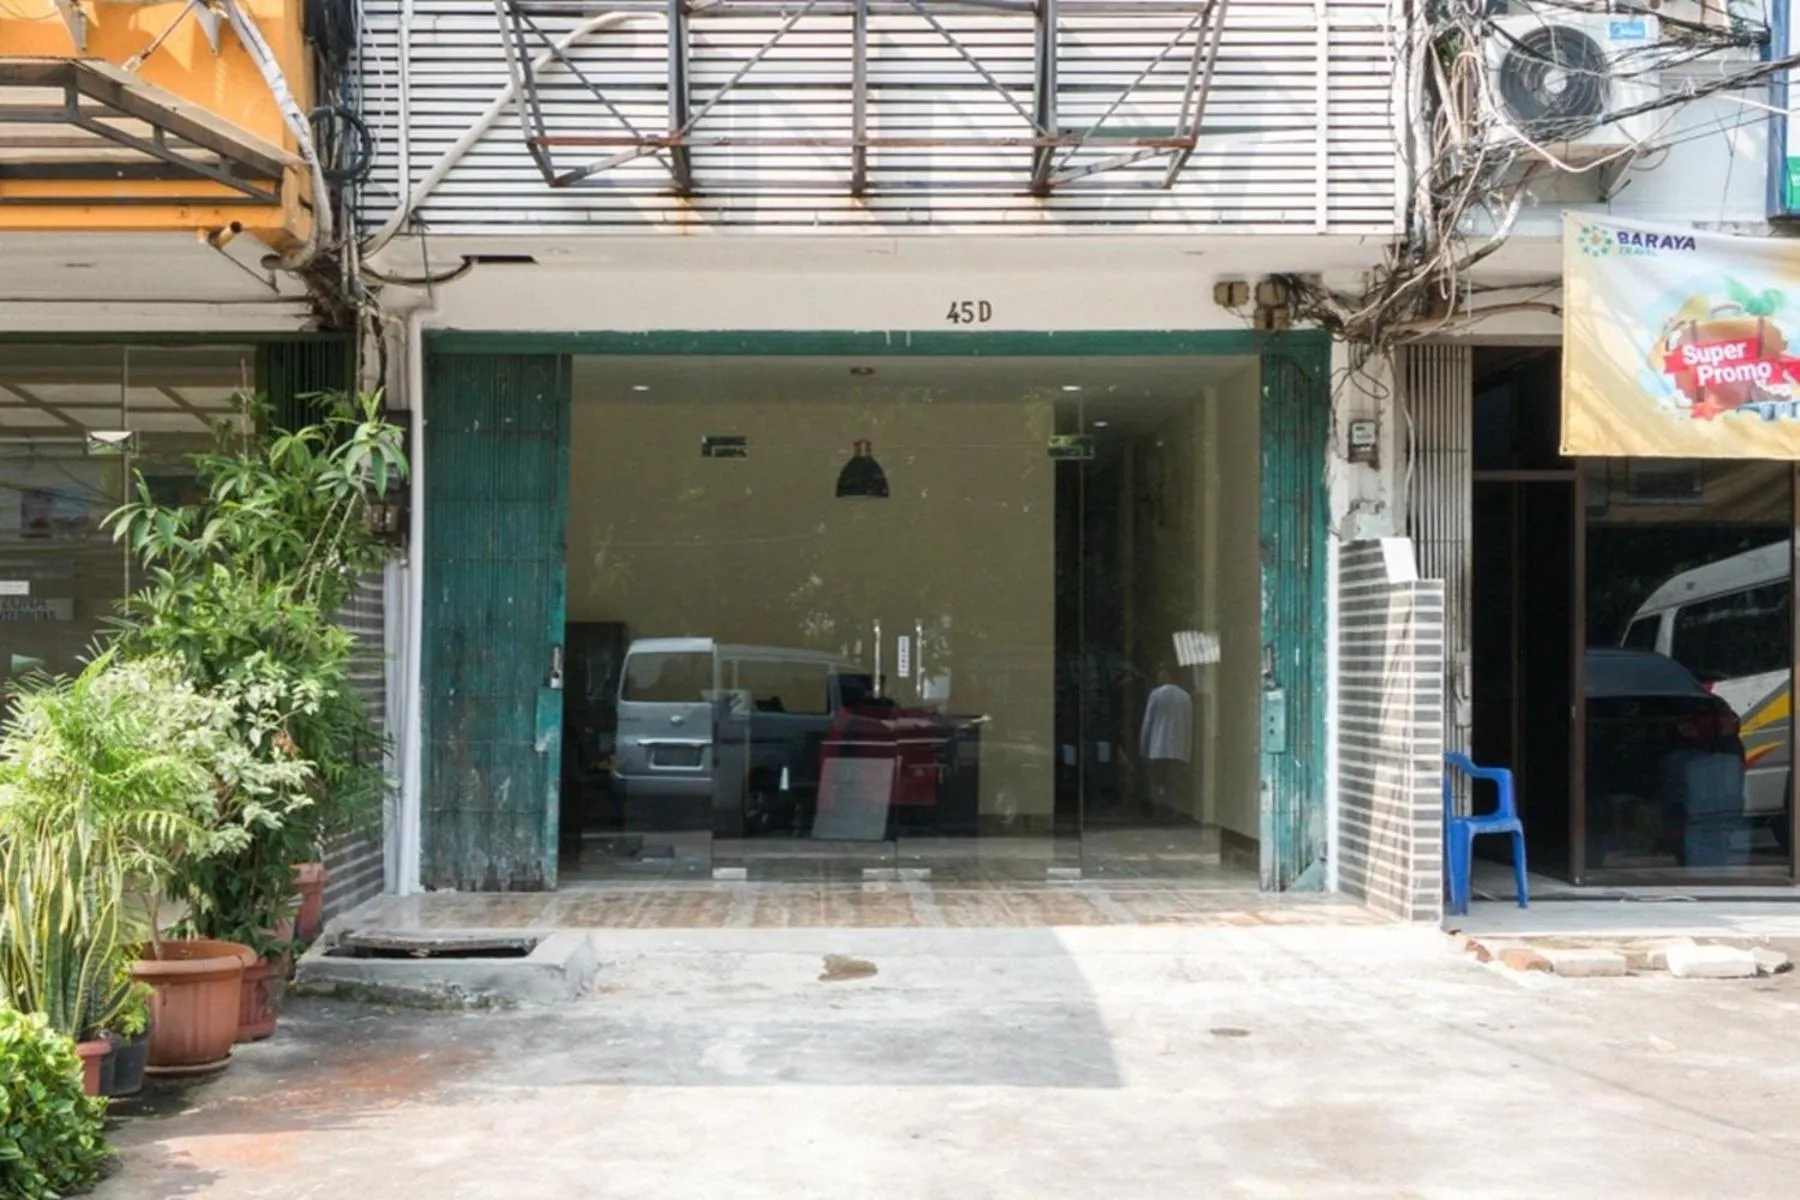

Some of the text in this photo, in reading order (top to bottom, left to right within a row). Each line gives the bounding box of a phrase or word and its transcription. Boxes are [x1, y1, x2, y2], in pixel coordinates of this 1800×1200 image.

[1616, 231, 1696, 251] BARAYA
[946, 300, 992, 324] 45D
[1681, 341, 1747, 366] Super
[1696, 361, 1772, 386] Promo
